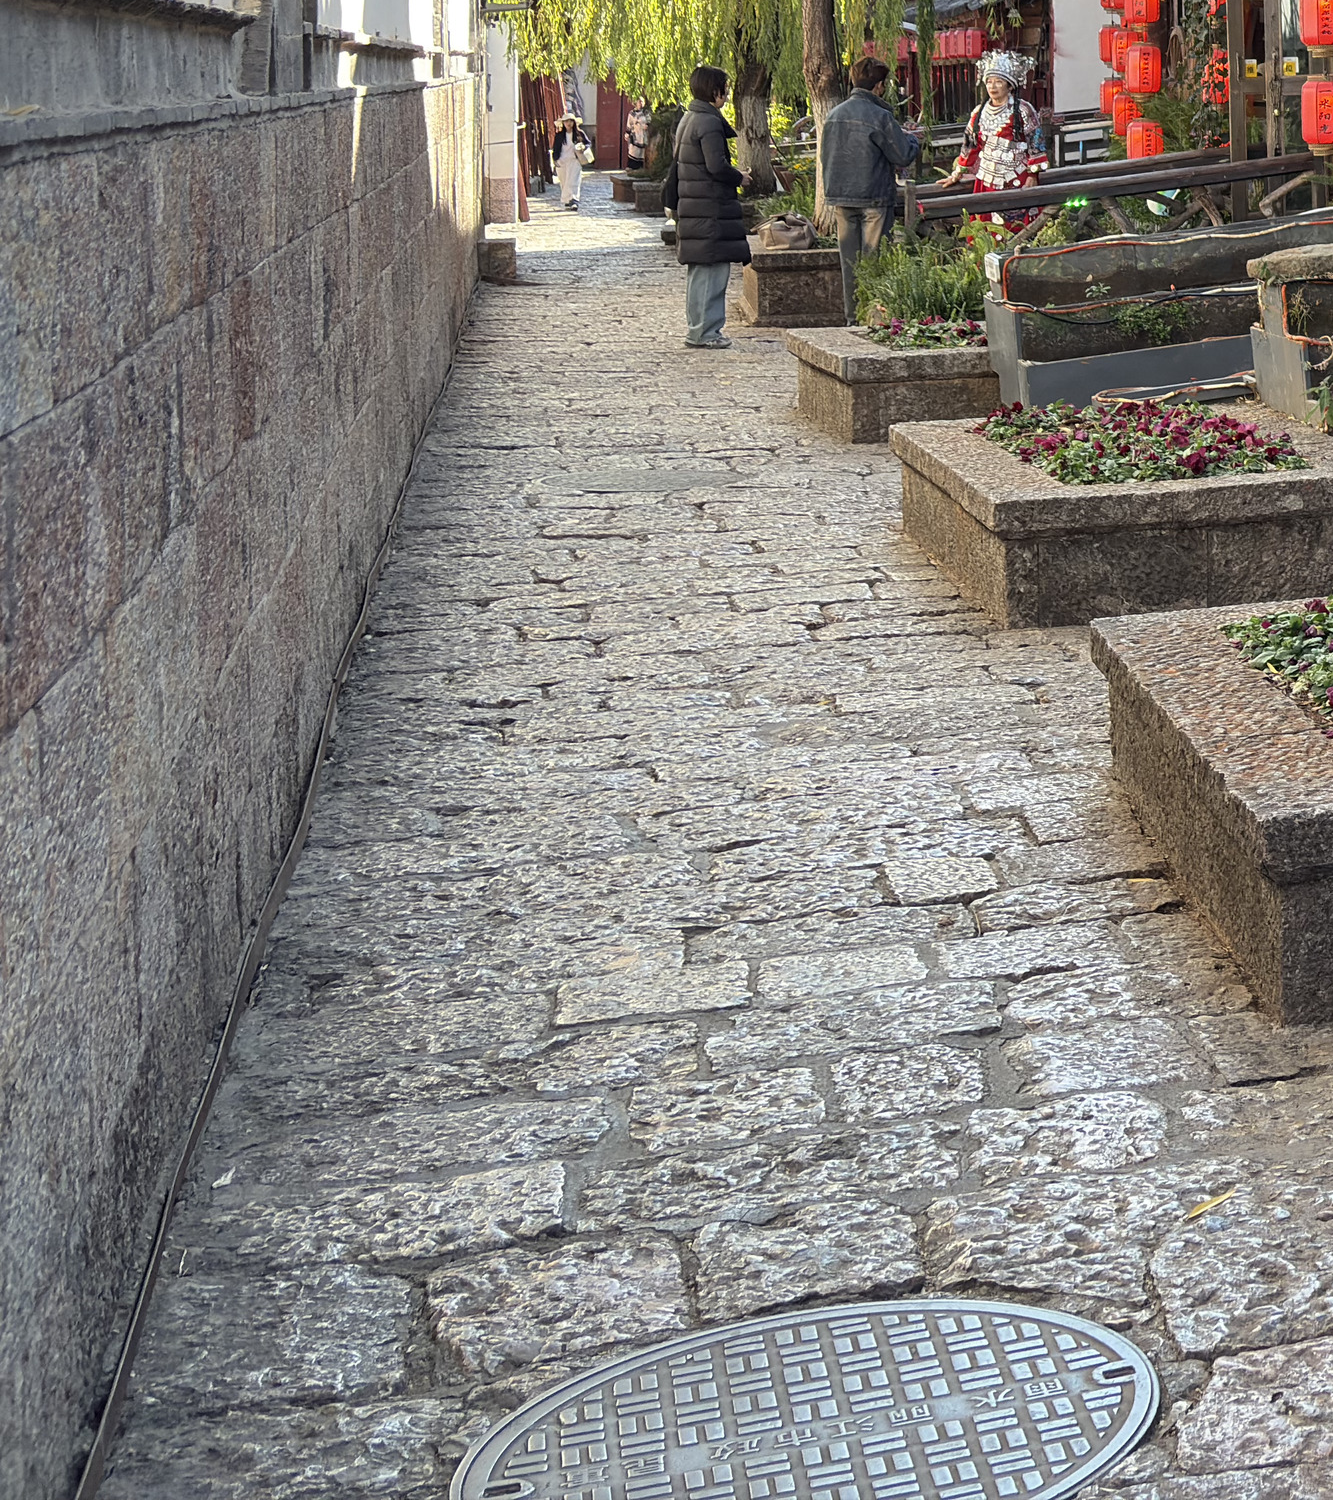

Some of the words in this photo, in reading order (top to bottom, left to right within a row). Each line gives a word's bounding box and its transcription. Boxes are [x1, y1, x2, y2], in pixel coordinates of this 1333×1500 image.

[1318, 89, 1332, 135] 一米阳光
[970, 1378, 1068, 1408] 雨水
[710, 1403, 934, 1461] 丽江市政
